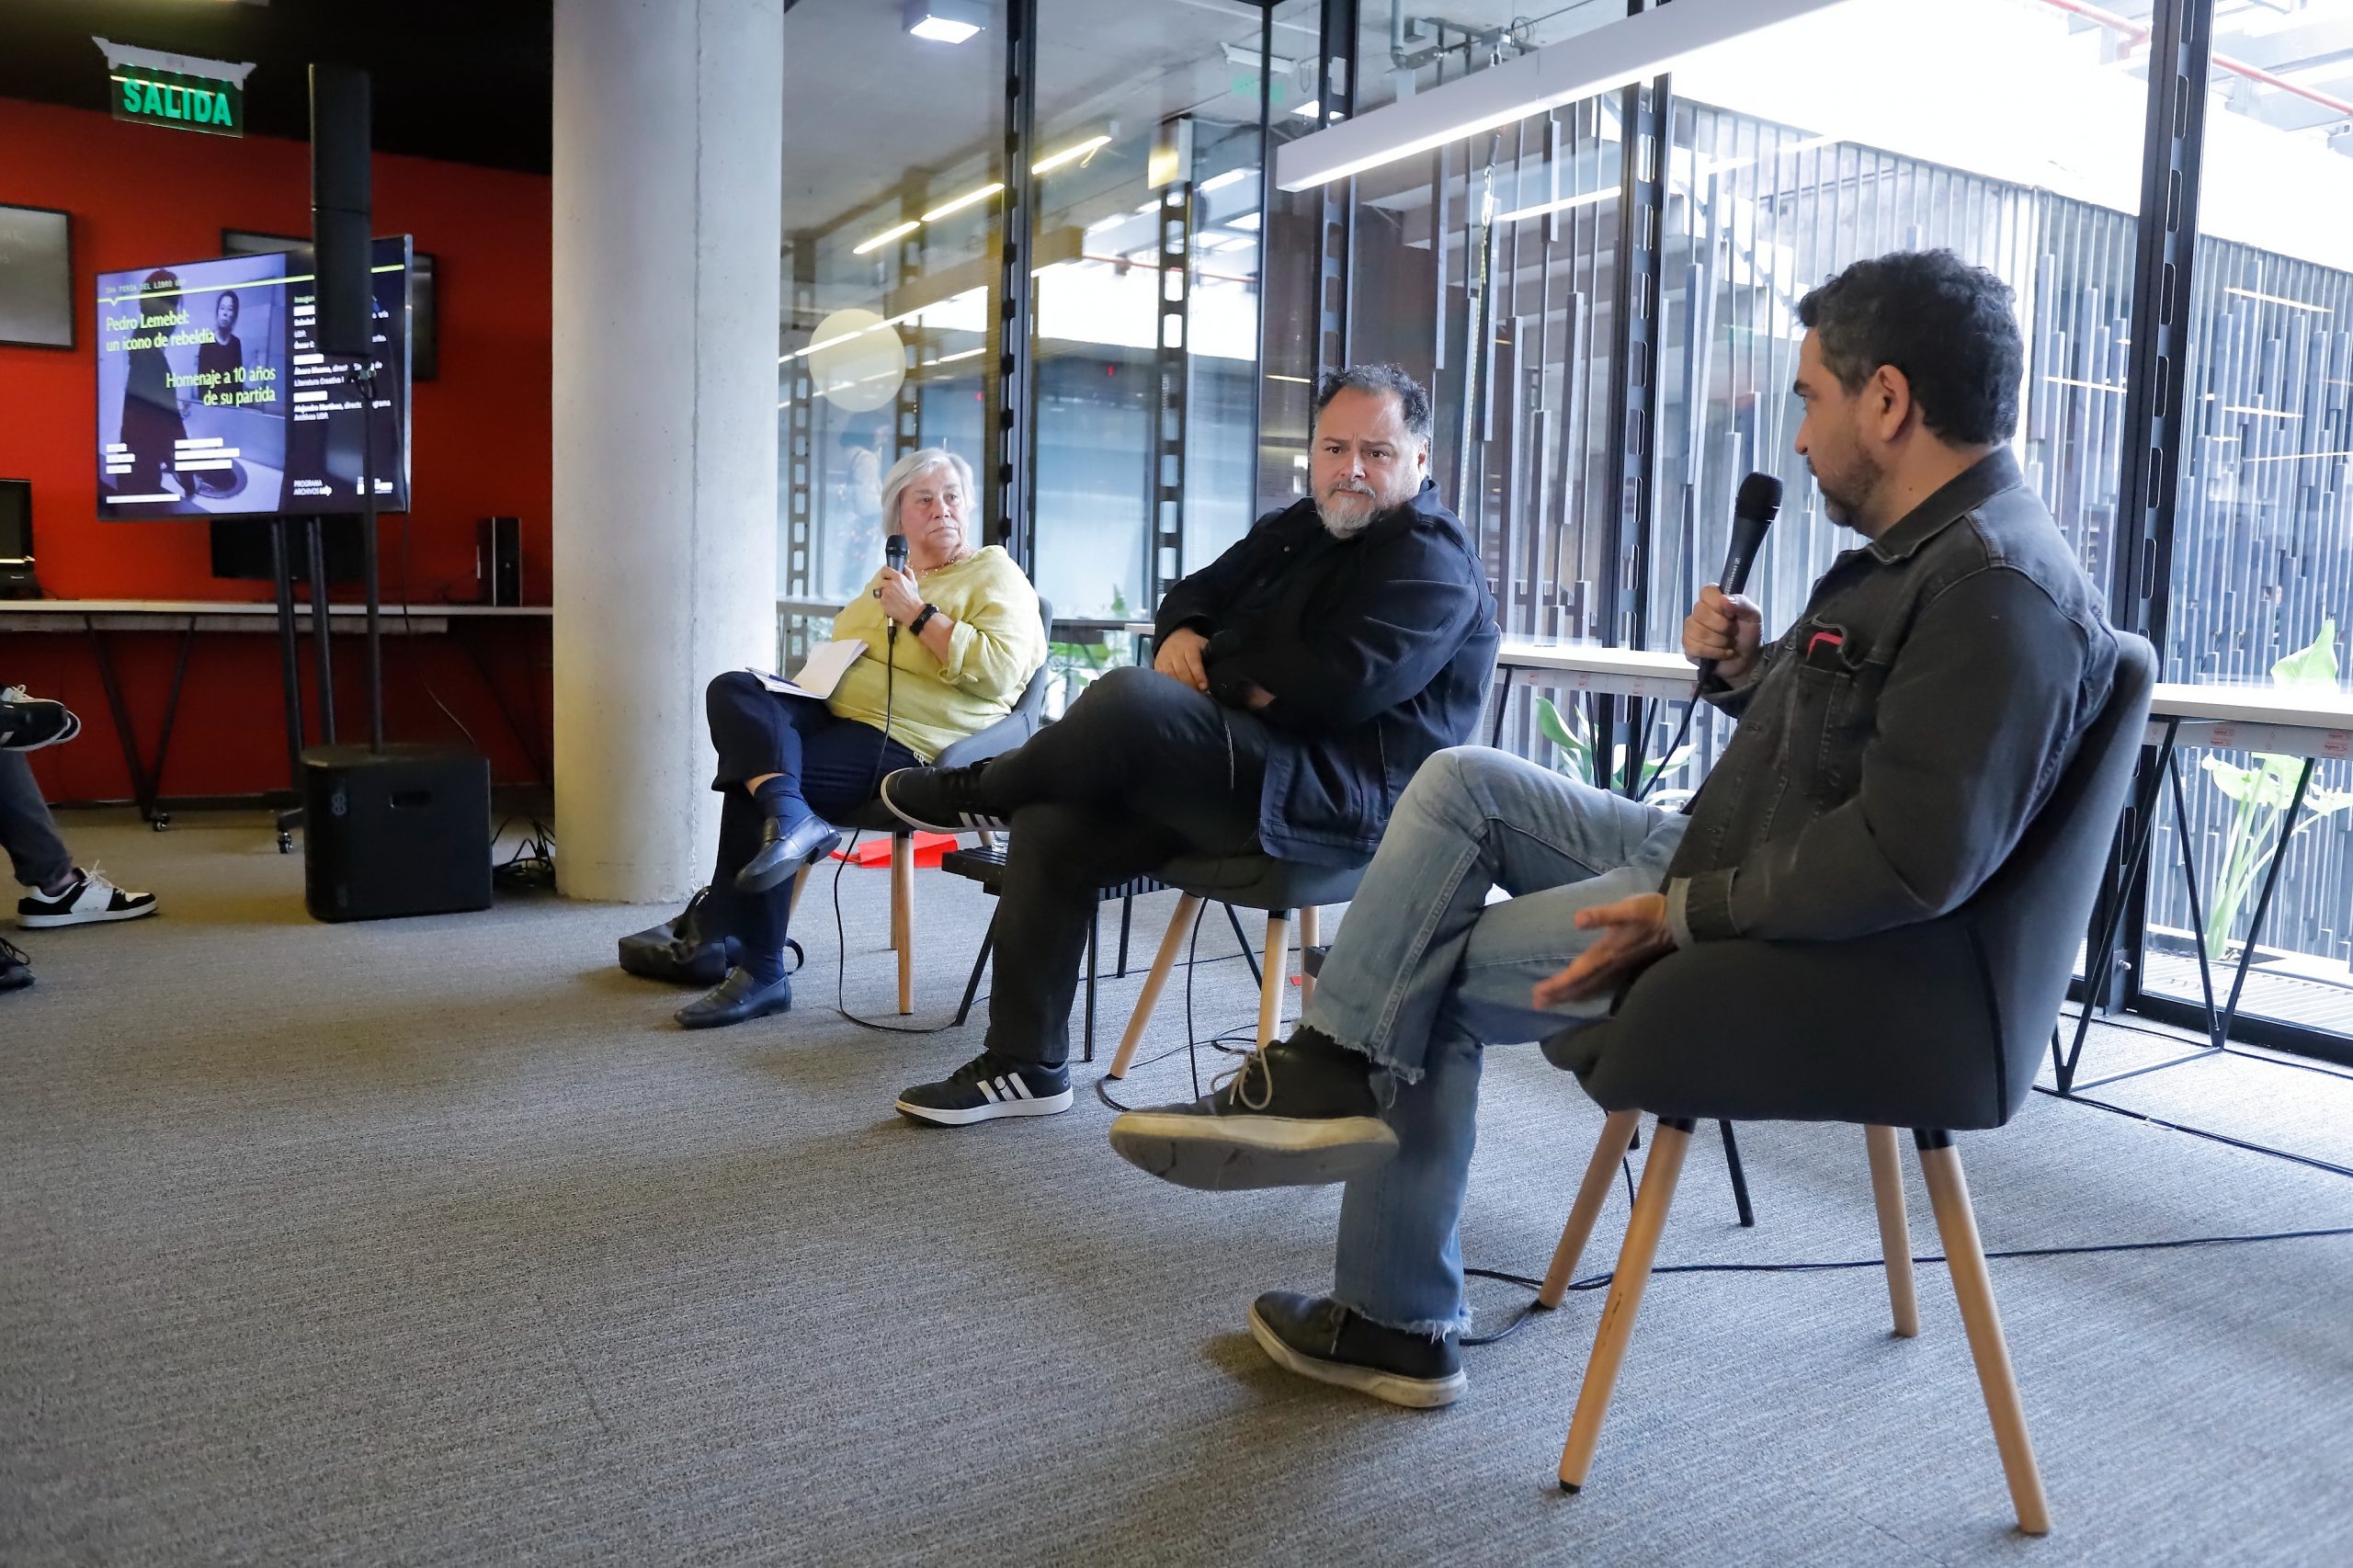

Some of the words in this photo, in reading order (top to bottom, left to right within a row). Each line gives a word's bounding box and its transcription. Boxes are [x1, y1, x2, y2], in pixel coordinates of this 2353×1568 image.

[123, 78, 233, 127] SALIDA
[106, 315, 138, 331] Pedro
[140, 309, 189, 329] Lemebel:
[106, 340, 119, 352] un
[153, 332, 168, 347] de
[165, 369, 222, 389] Homenaje
[222, 372, 232, 384] a
[233, 367, 246, 383] 10
[249, 365, 277, 381] años
[203, 390, 218, 406] de
[220, 392, 233, 405] su
[235, 385, 277, 408] partida
